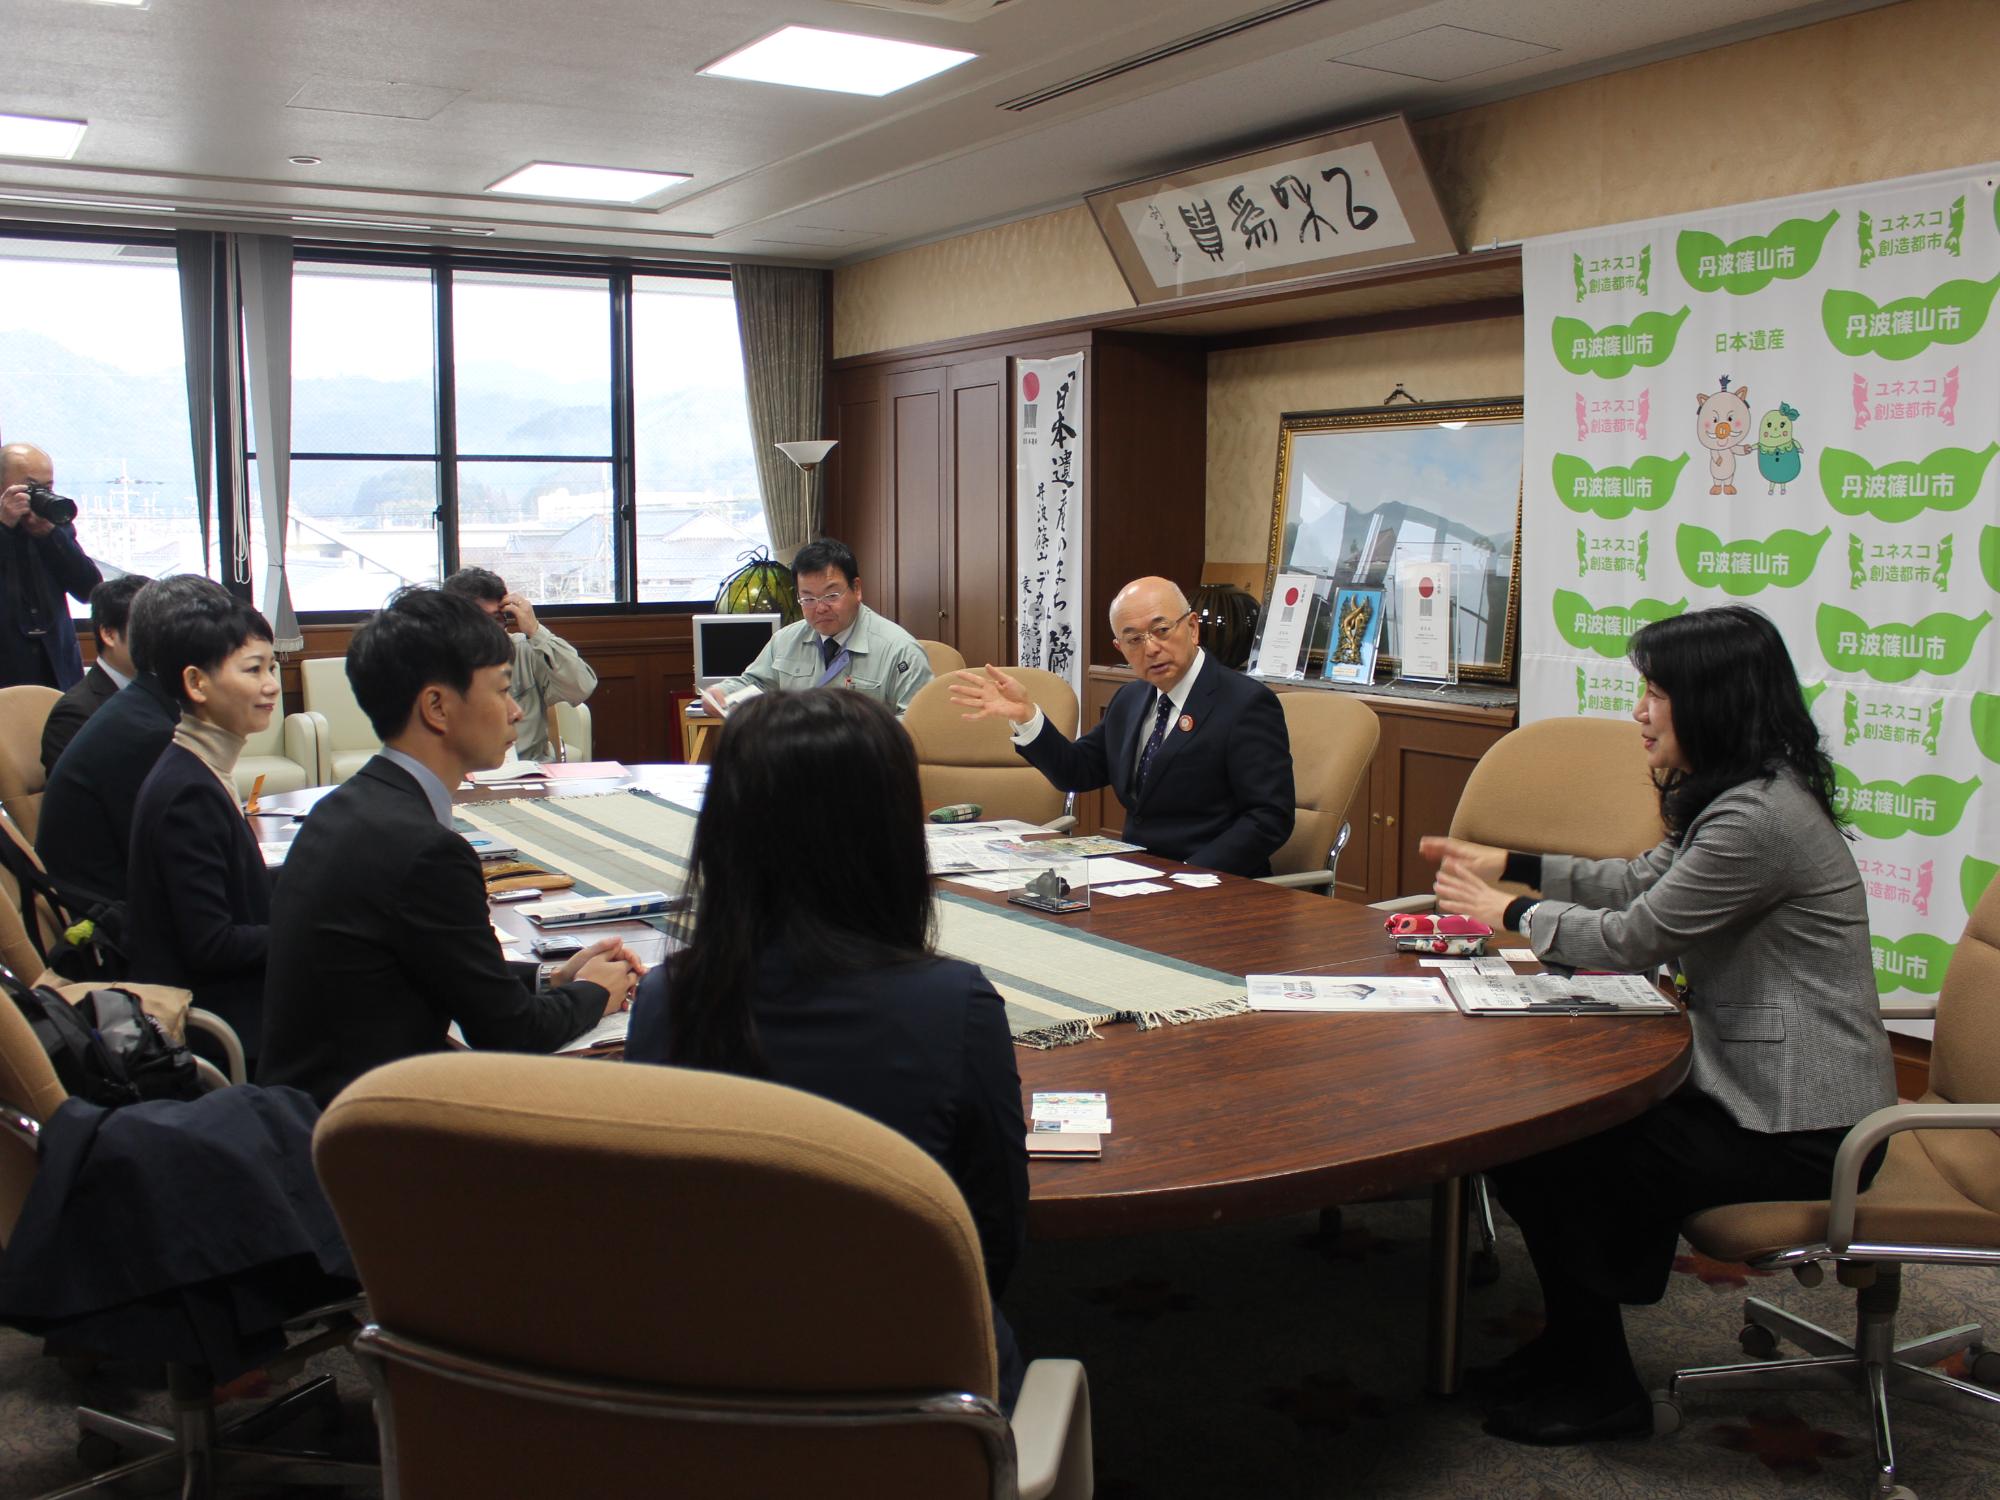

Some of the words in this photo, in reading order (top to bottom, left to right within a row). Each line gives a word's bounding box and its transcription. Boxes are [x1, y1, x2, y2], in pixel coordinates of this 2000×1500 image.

[1878, 209, 1943, 233] ユネスコ
[1878, 231, 1944, 258] 創造都市
[1588, 255, 1636, 274] ユネスコ
[1698, 245, 1795, 280] 丹波篠山市
[1588, 276, 1636, 294] 創造都市
[1846, 304, 1962, 340] 丹波篠山市
[1571, 333, 1654, 358] 丹波篠山市
[1715, 328, 1785, 354] 日本遺産
[1874, 378, 1937, 397] ユネスコ
[1590, 399, 1635, 414] ユネスコ
[1873, 400, 1937, 422] 創造都市
[1590, 415, 1635, 434] 創造都市
[1572, 475, 1653, 499] 丹波篠山市
[1841, 472, 1955, 499] 丹波篠山市
[1590, 536, 1635, 553] ユネスコ
[1870, 542, 1931, 560] ユネスコ
[1589, 555, 1636, 573] 創造都市
[1696, 551, 1790, 576] 丹波篠山市
[1869, 564, 1931, 583] 創造都市
[1837, 631, 1947, 661] 丹波篠山市
[1589, 677, 1634, 693] ユネスコ
[1588, 695, 1634, 712] 創造都市
[1864, 702, 1922, 723] ユネスコ
[1863, 723, 1921, 746] 創造都市
[1834, 786, 1937, 822] 丹波篠山市
[1857, 858, 1912, 881] ユネスコ
[1872, 946, 1929, 979] 篠山市
